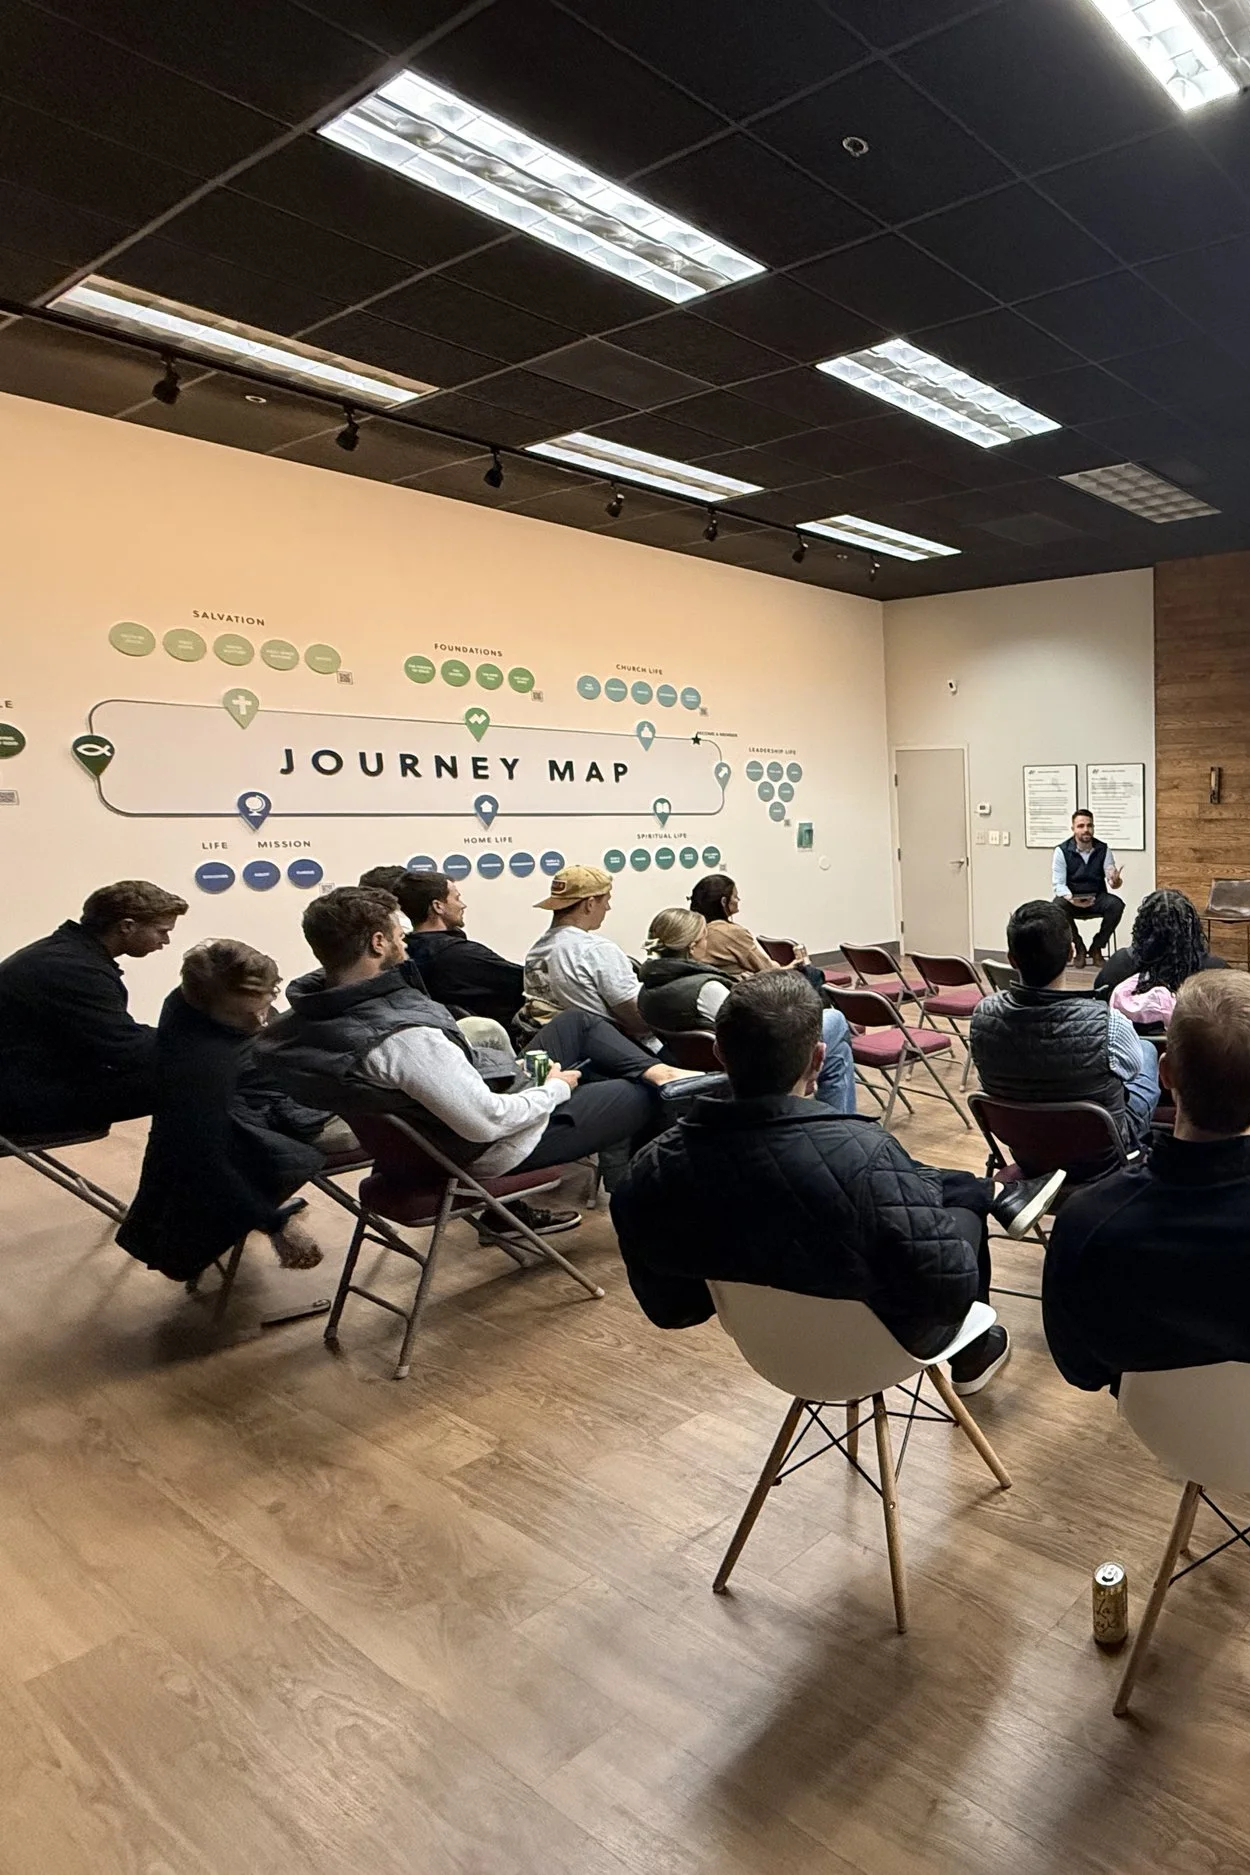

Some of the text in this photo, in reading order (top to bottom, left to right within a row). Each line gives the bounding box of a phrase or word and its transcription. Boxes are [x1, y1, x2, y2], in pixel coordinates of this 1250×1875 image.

[192, 609, 265, 628] SALVATION
[434, 643, 503, 657] FOUNDATIONS
[615, 663, 663, 676] CHURCH LIFE
[279, 748, 629, 784] JOURNEY MAP
[201, 840, 311, 850] LIFE MISSION
[463, 836, 513, 844] HOME LIFE
